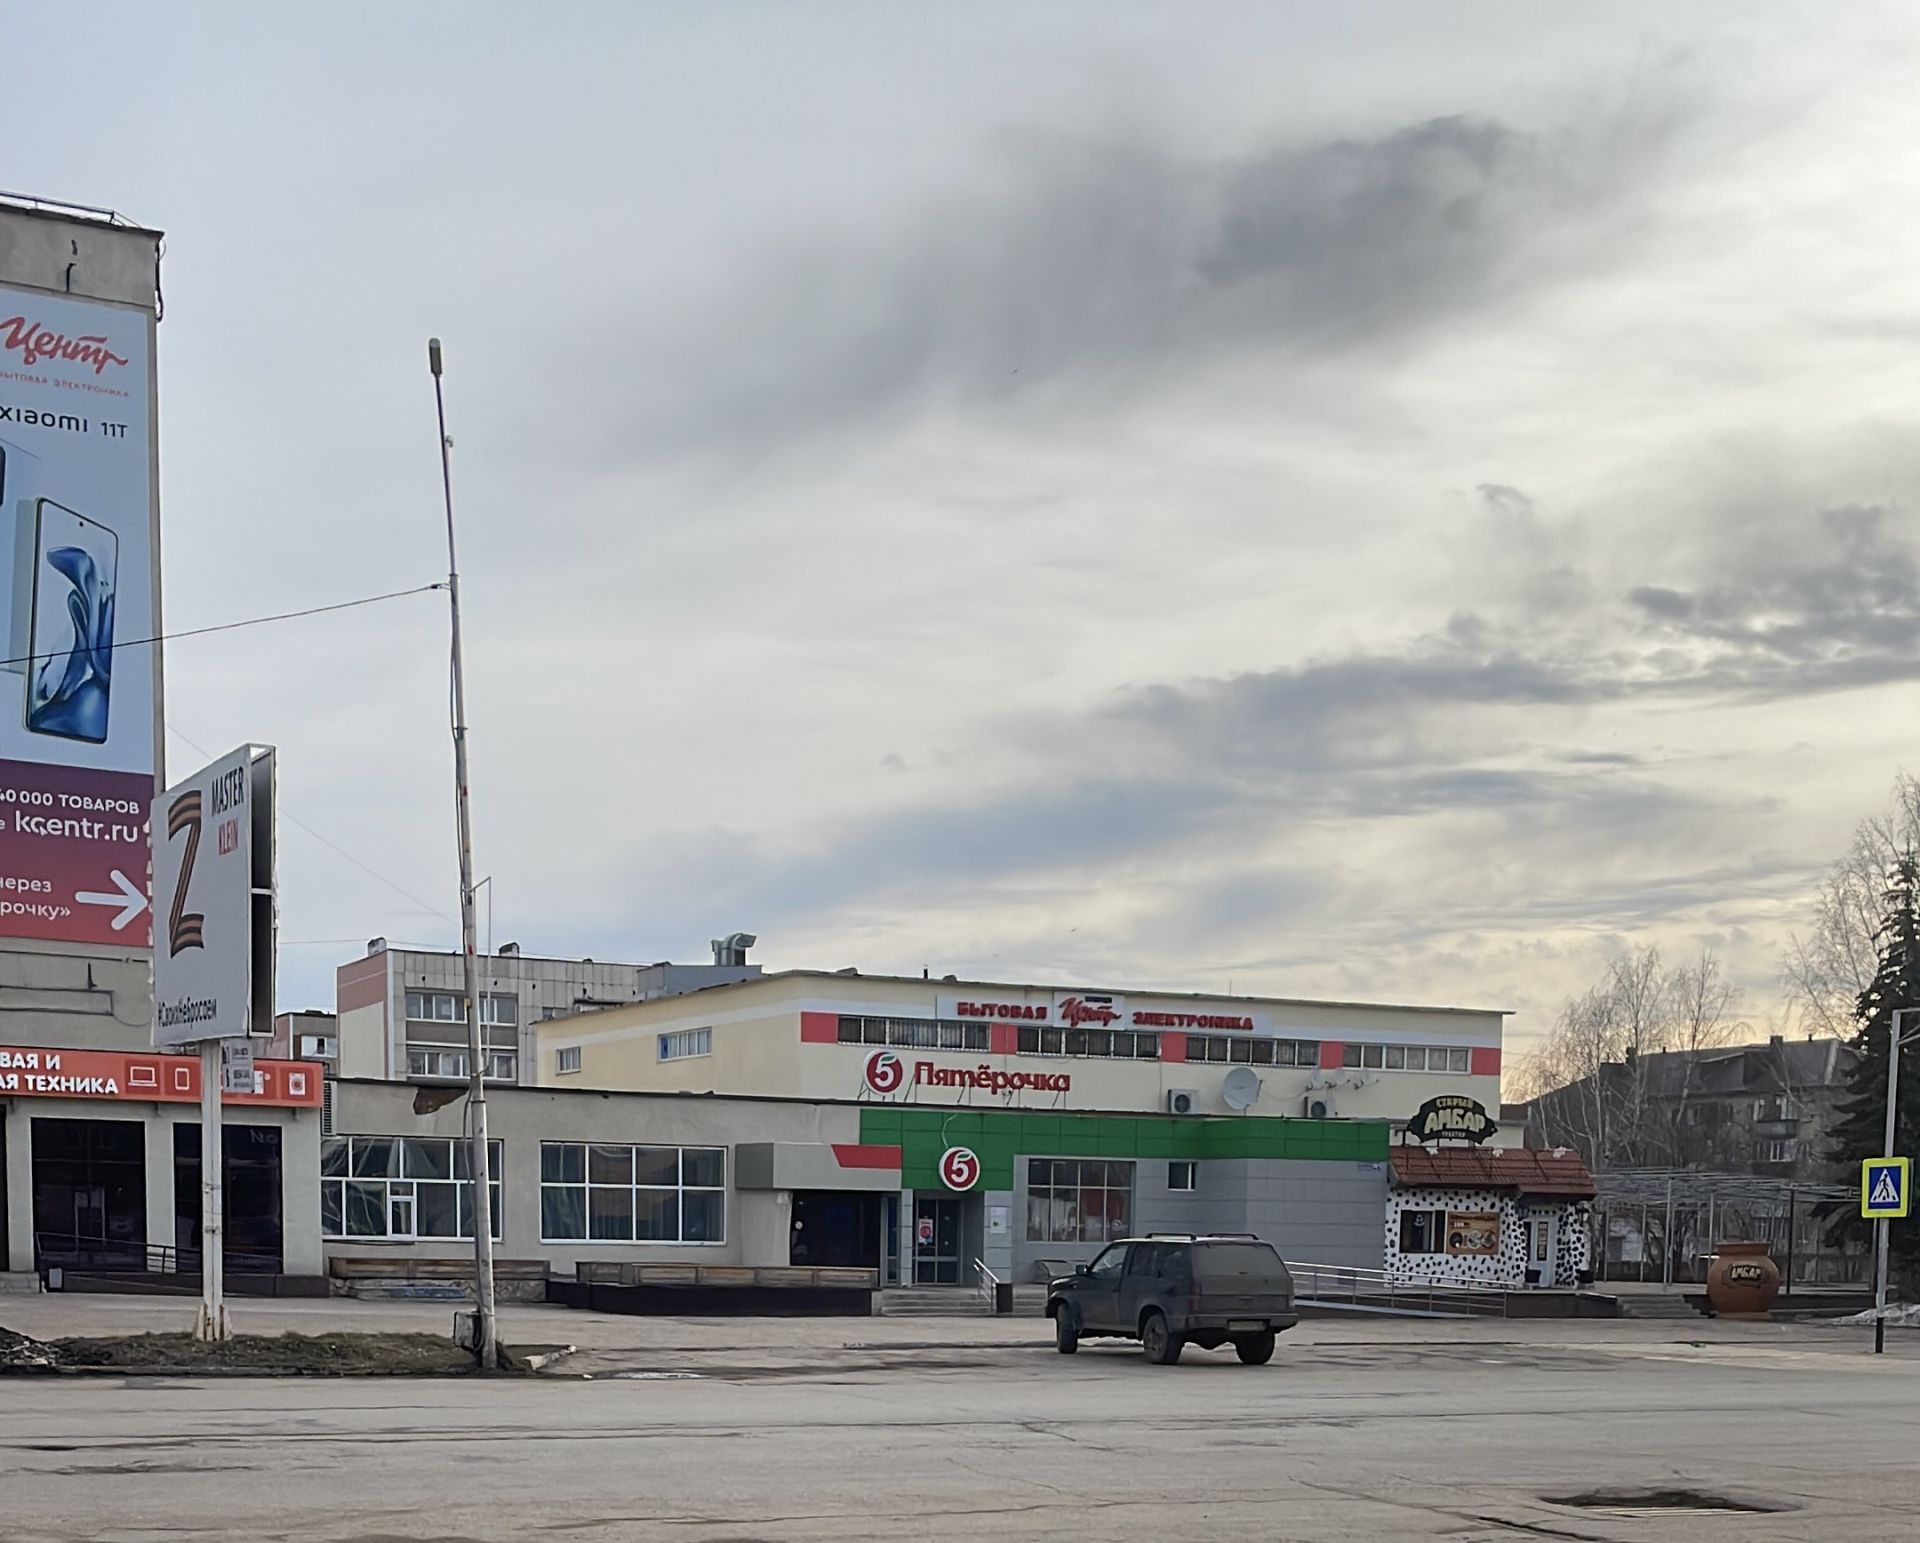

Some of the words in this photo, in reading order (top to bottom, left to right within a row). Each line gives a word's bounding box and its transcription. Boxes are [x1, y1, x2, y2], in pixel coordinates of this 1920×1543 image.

[0, 316, 129, 375] Центр
[53, 378, 129, 398] ЭЛЕКТРОНИКА
[58, 793, 140, 815] ТОВАРОВ
[211, 765, 245, 817] MASTER
[15, 809, 139, 843] kcentr.ru
[957, 1002, 1047, 1019] БЫТОВАЯ
[1058, 996, 1122, 1027] Центр
[1132, 1011, 1254, 1031] ЭЛЕКТРОНИКА
[45, 1054, 61, 1070] И
[25, 1074, 118, 1094] ТЕХНИКА
[914, 1063, 1071, 1095] Пятёрочка
[1423, 1107, 1486, 1134] АМБАР
